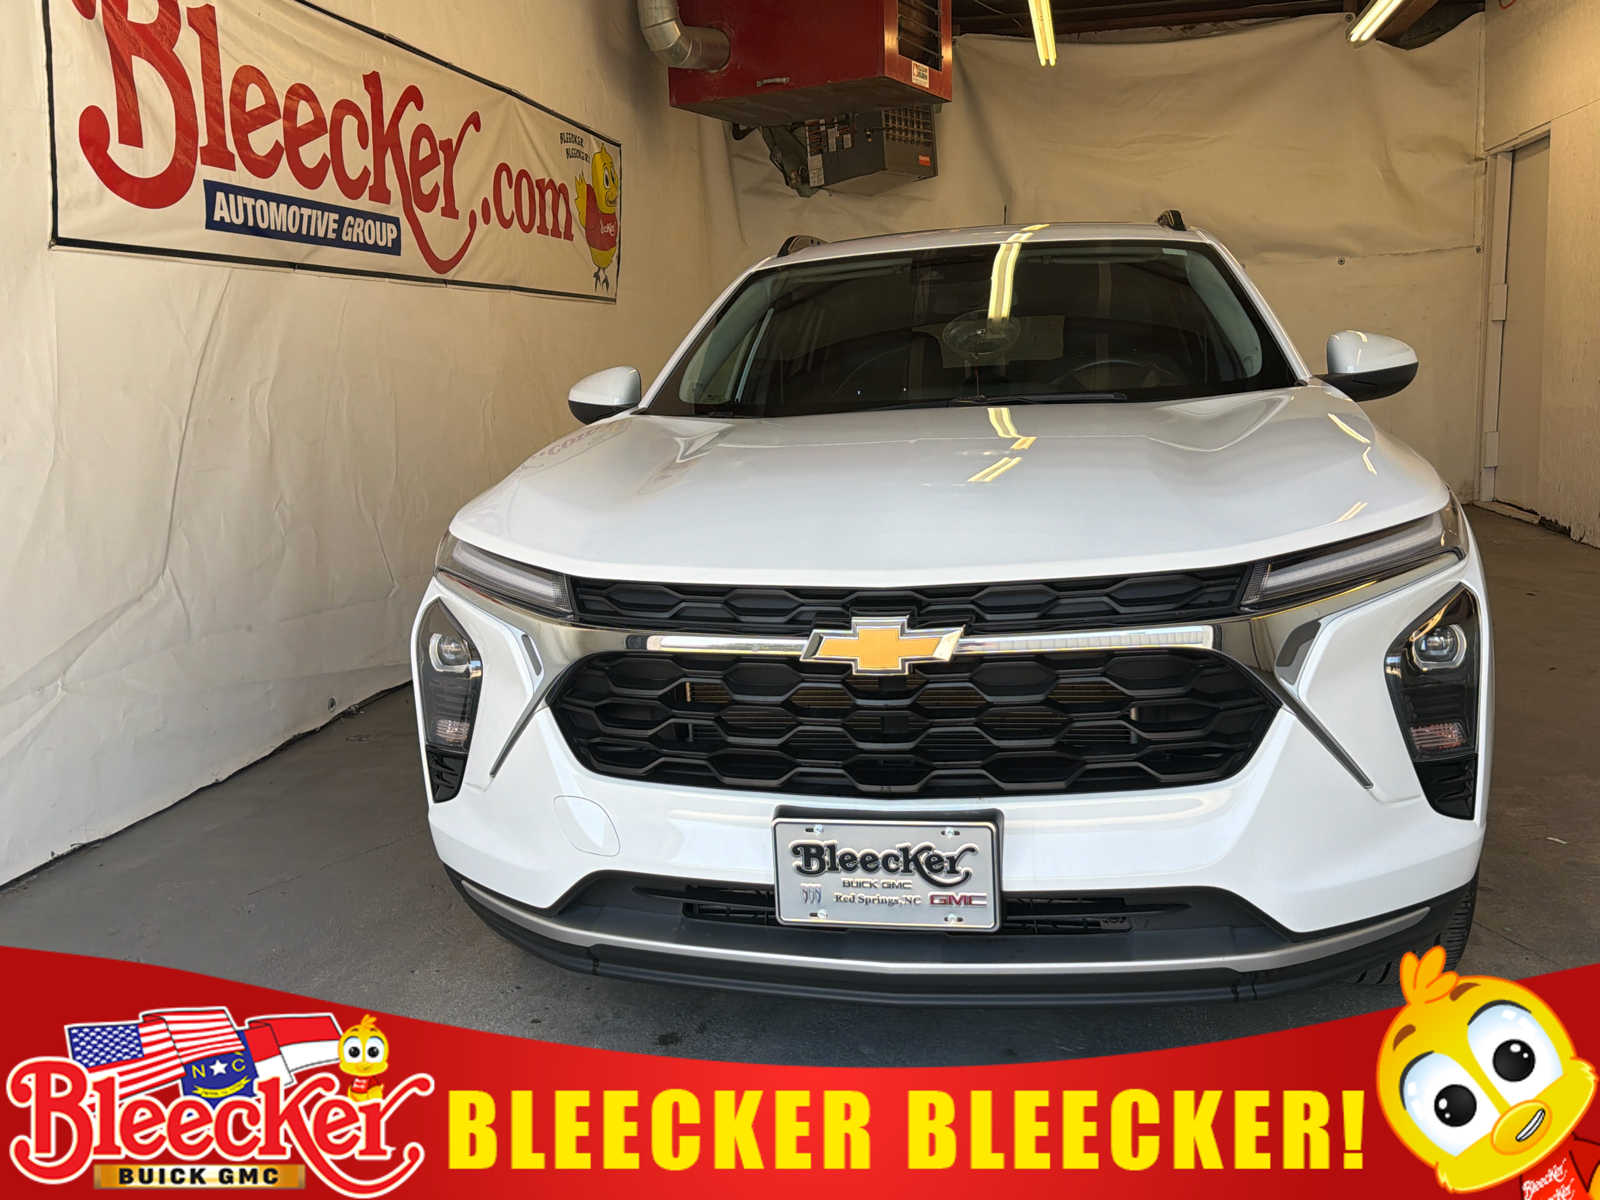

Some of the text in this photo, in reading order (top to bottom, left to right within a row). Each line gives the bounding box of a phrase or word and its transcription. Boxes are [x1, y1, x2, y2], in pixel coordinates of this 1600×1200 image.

[213, 192, 398, 249] AUTOMOTIVE GROUP
[842, 879, 912, 889] BUICK GMC
[834, 893, 856, 904] Red
[929, 893, 987, 906] GMC
